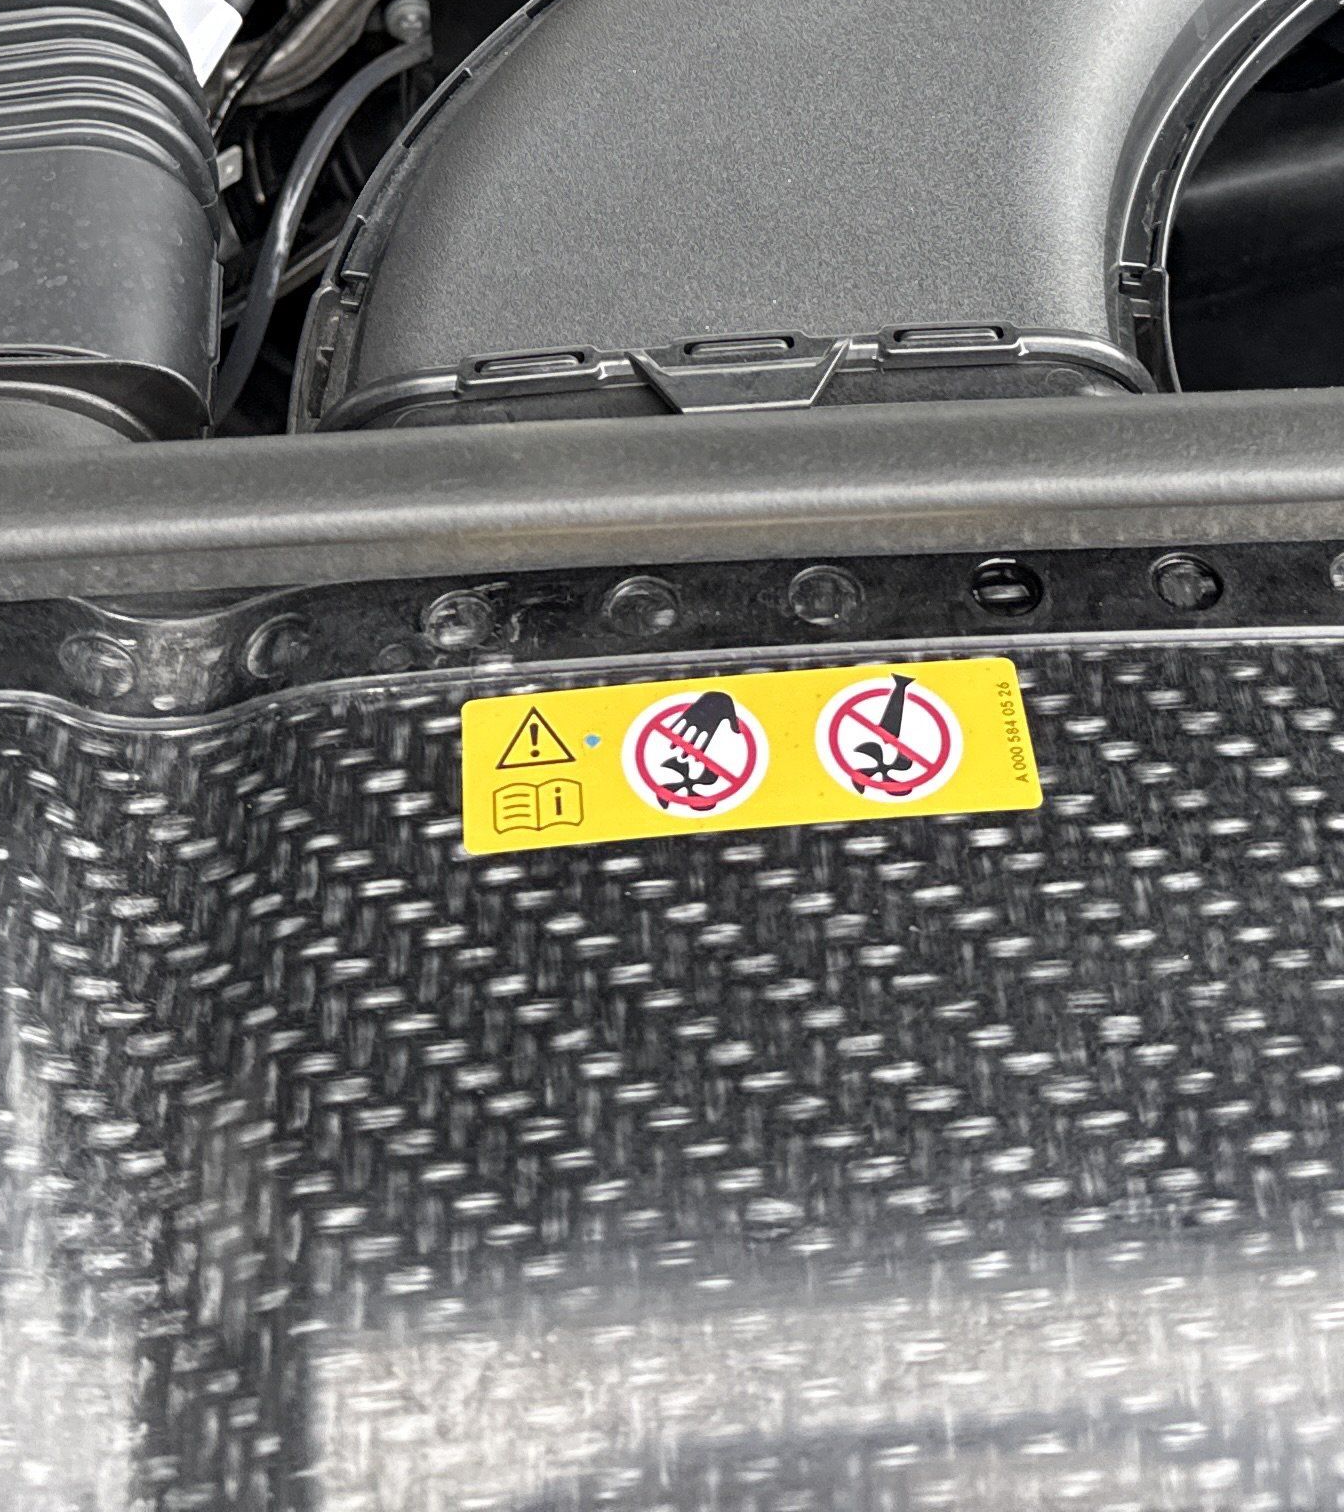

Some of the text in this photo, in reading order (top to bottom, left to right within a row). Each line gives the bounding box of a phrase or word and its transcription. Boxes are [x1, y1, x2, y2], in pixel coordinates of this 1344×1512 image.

[996, 681, 1030, 783] A 000 584 05 26
